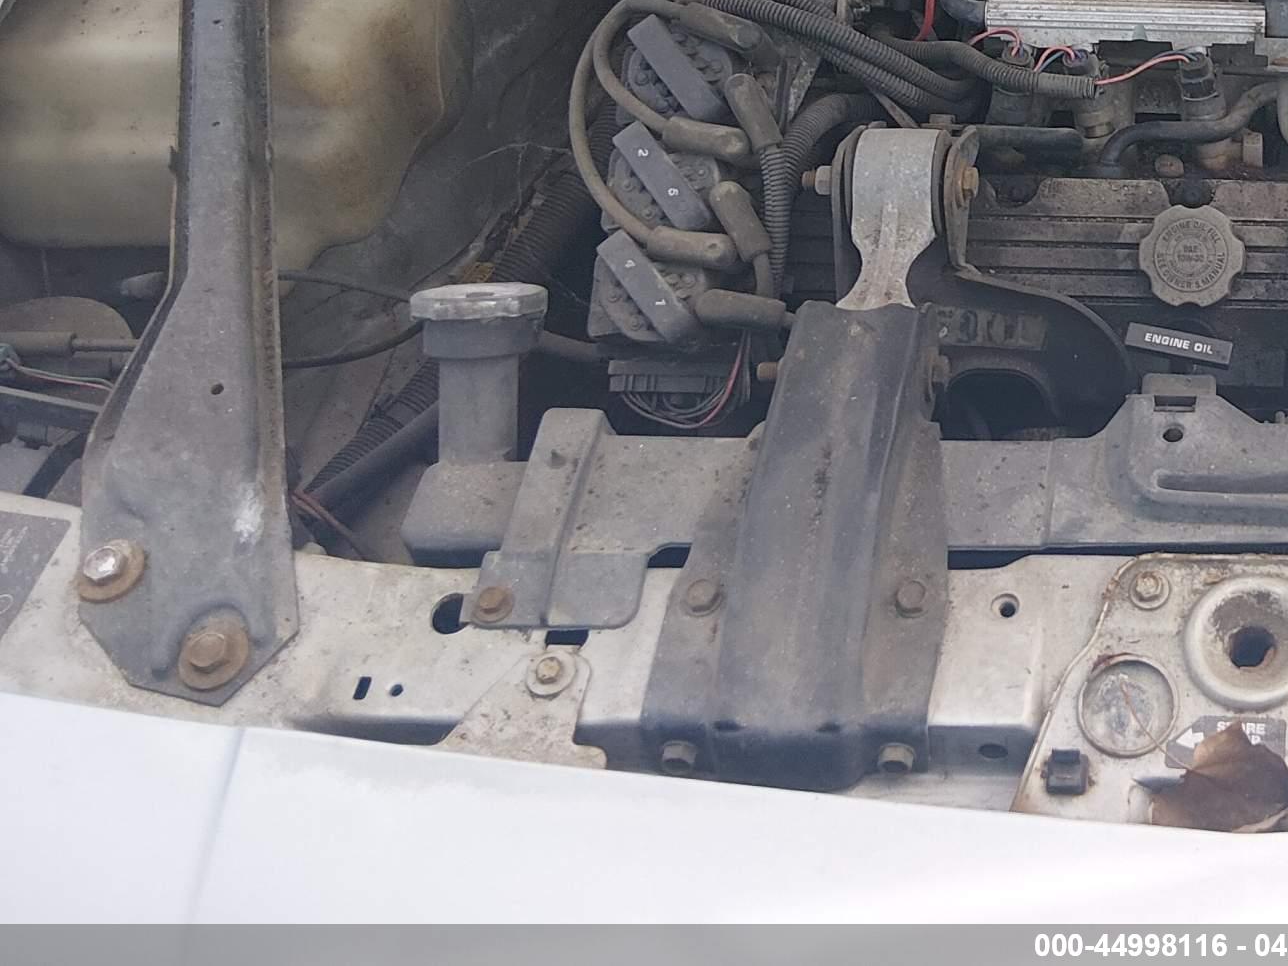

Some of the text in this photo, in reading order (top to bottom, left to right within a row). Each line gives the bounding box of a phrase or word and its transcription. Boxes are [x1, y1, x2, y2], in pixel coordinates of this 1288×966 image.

[637, 148, 650, 158] 2
[1163, 220, 1192, 243] ENGINE
[1193, 220, 1208, 232] OIL
[1202, 251, 1226, 287] MANUAL
[655, 299, 667, 307] 1
[1144, 332, 1214, 355] ENGINE OIL
